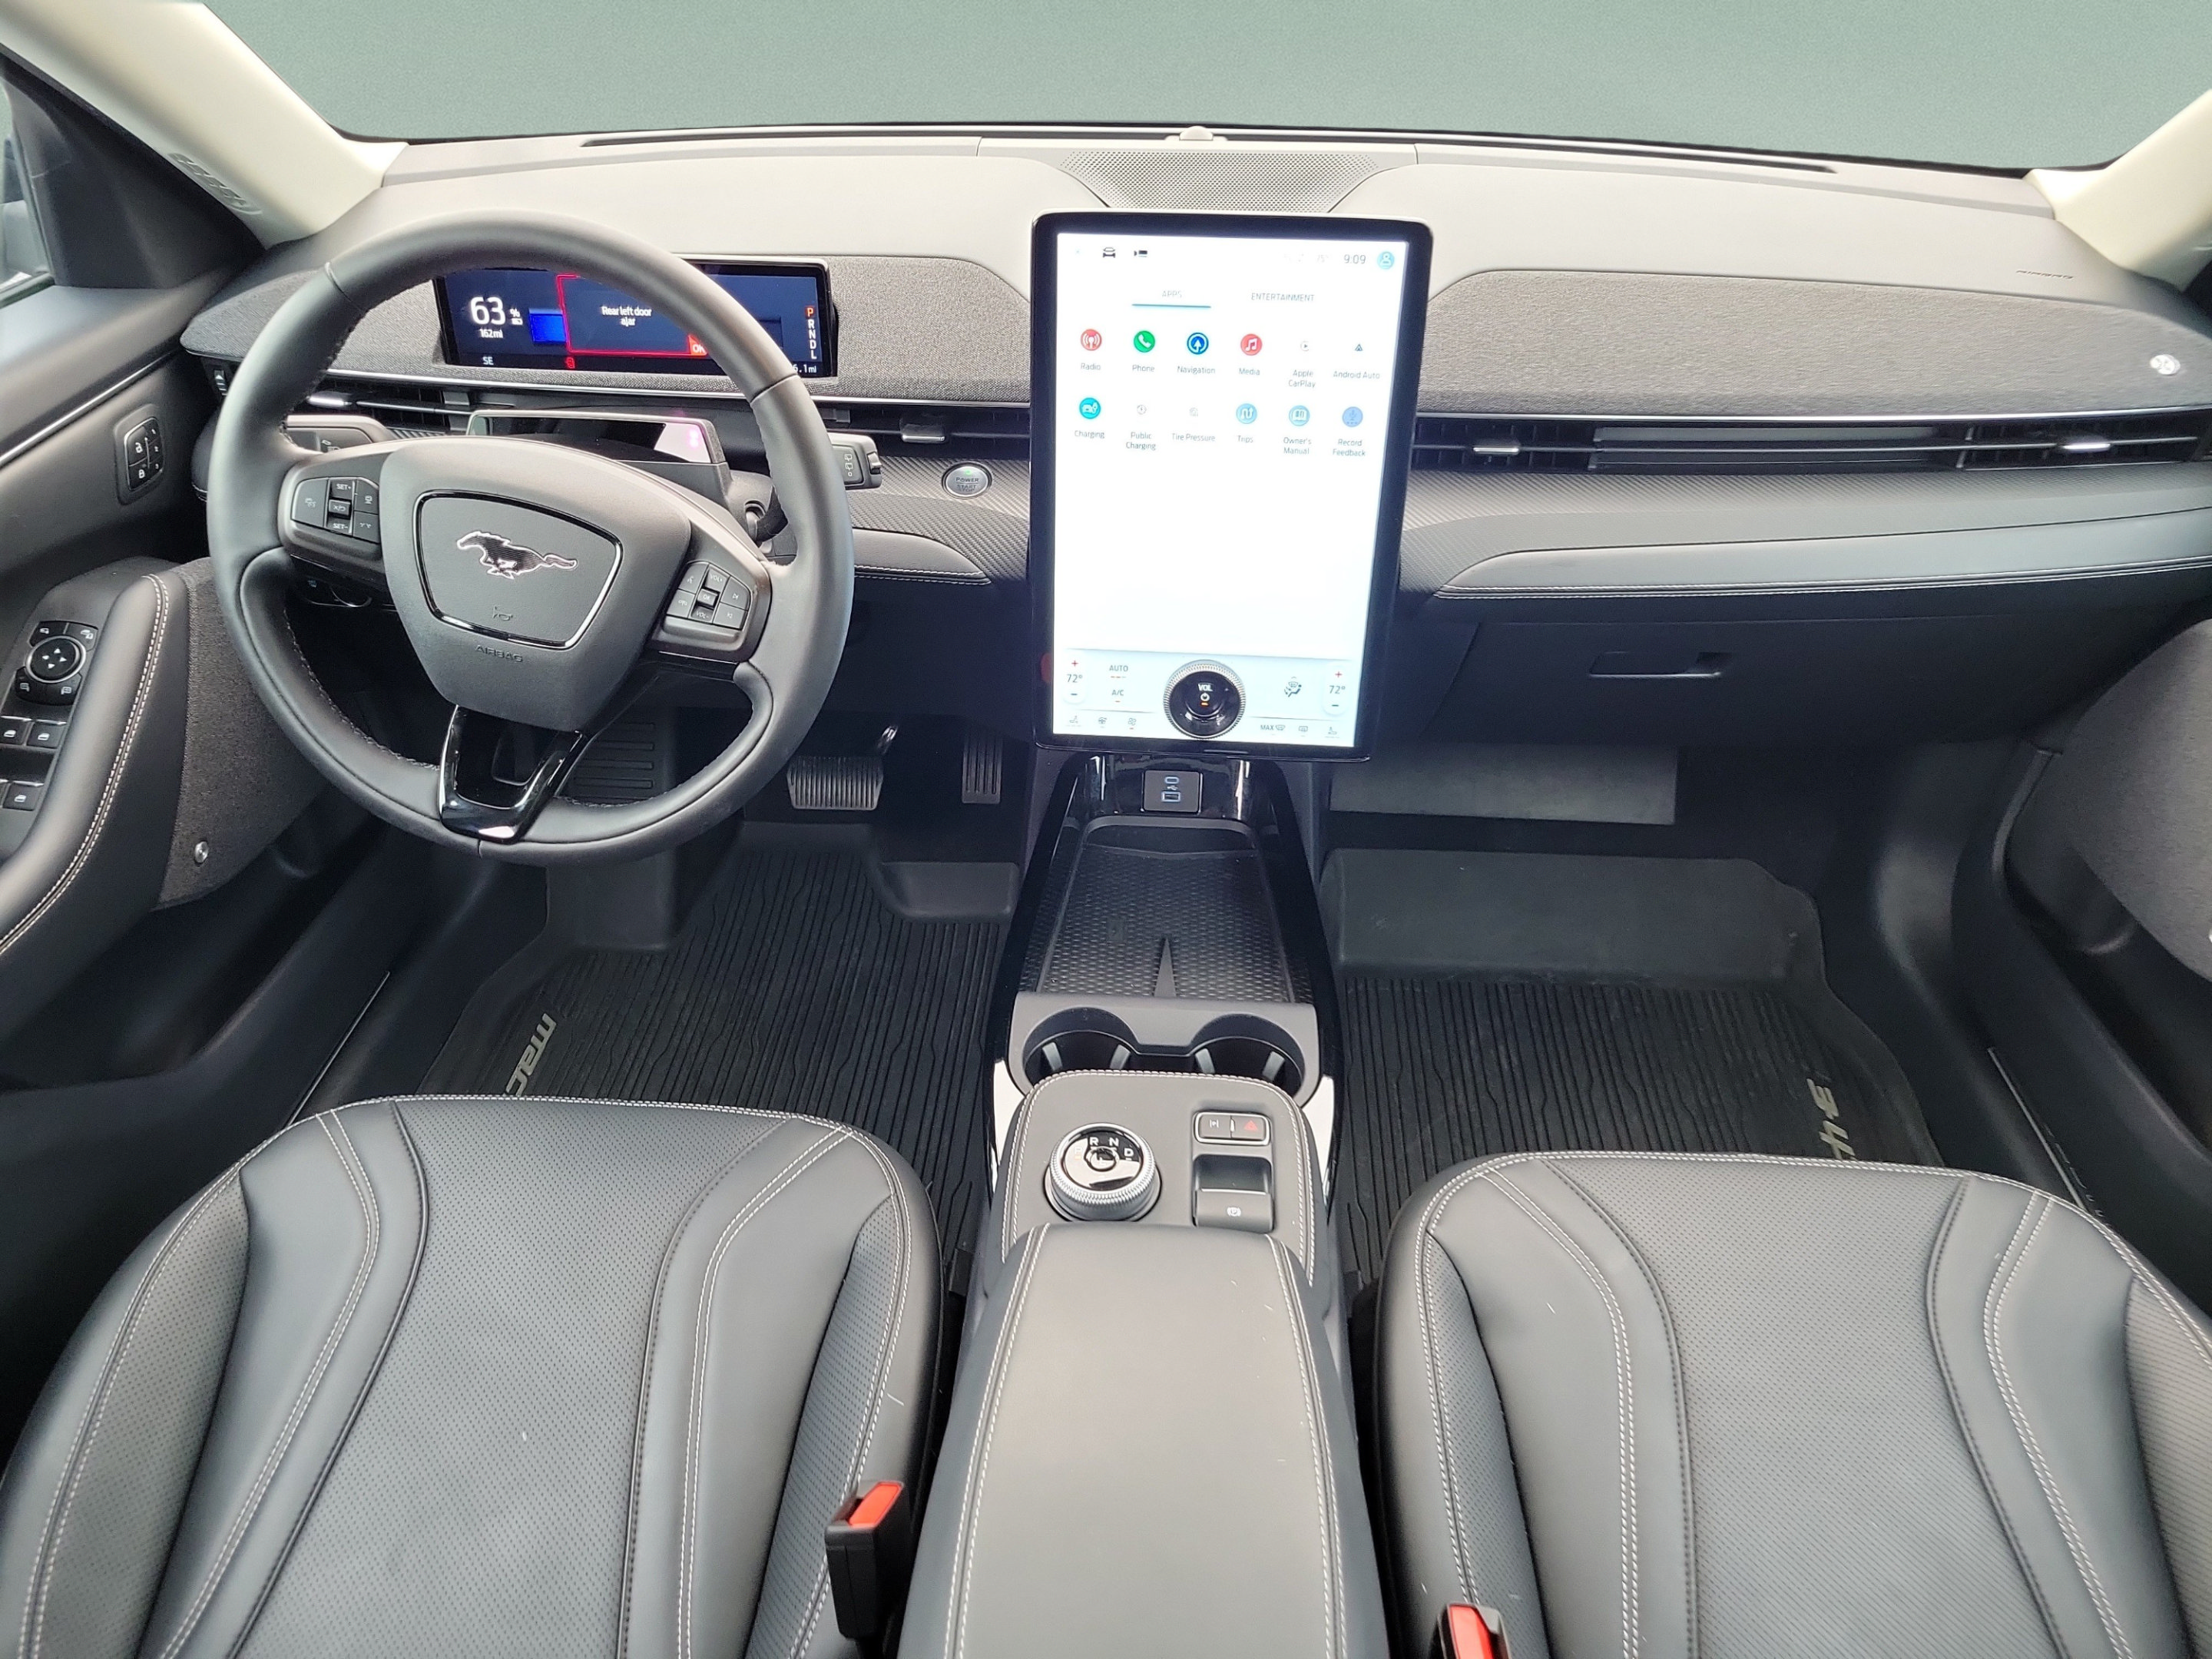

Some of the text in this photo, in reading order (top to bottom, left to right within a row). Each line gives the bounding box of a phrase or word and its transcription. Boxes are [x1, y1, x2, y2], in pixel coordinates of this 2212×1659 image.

[1343, 254, 1366, 264] 9:09
[1161, 290, 1182, 298] APPS
[1251, 293, 1315, 302] ENTERTAINMENT
[470, 296, 506, 326] 63
[601, 306, 652, 316] Rear left door
[621, 316, 636, 327] ajar
[479, 328, 504, 339] 162mi
[482, 356, 494, 366] SE
[1081, 362, 1101, 371] Radio
[1132, 364, 1155, 373] Phone
[1177, 365, 1216, 375] Navigation
[1238, 367, 1260, 376] Media
[1293, 369, 1313, 378] Apple
[1288, 379, 1316, 389] CarPlay
[1075, 429, 1105, 439] Charging
[1131, 431, 1152, 439] Public
[1171, 432, 1216, 442] Tire Pressure
[1237, 435, 1253, 444] Trips
[1283, 436, 1312, 445] Owner's
[1125, 442, 1157, 451] Charging
[1283, 446, 1310, 455] Manual
[1333, 449, 1366, 457] Feedback
[475, 644, 523, 663] AIRBAG
[1066, 674, 1083, 683] 72°
[1198, 683, 1214, 691] VOL
[1329, 685, 1346, 694] 72°
[1089, 1137, 1099, 1146] R
[1109, 1137, 1119, 1147] N
[1124, 1147, 1134, 1157] D
